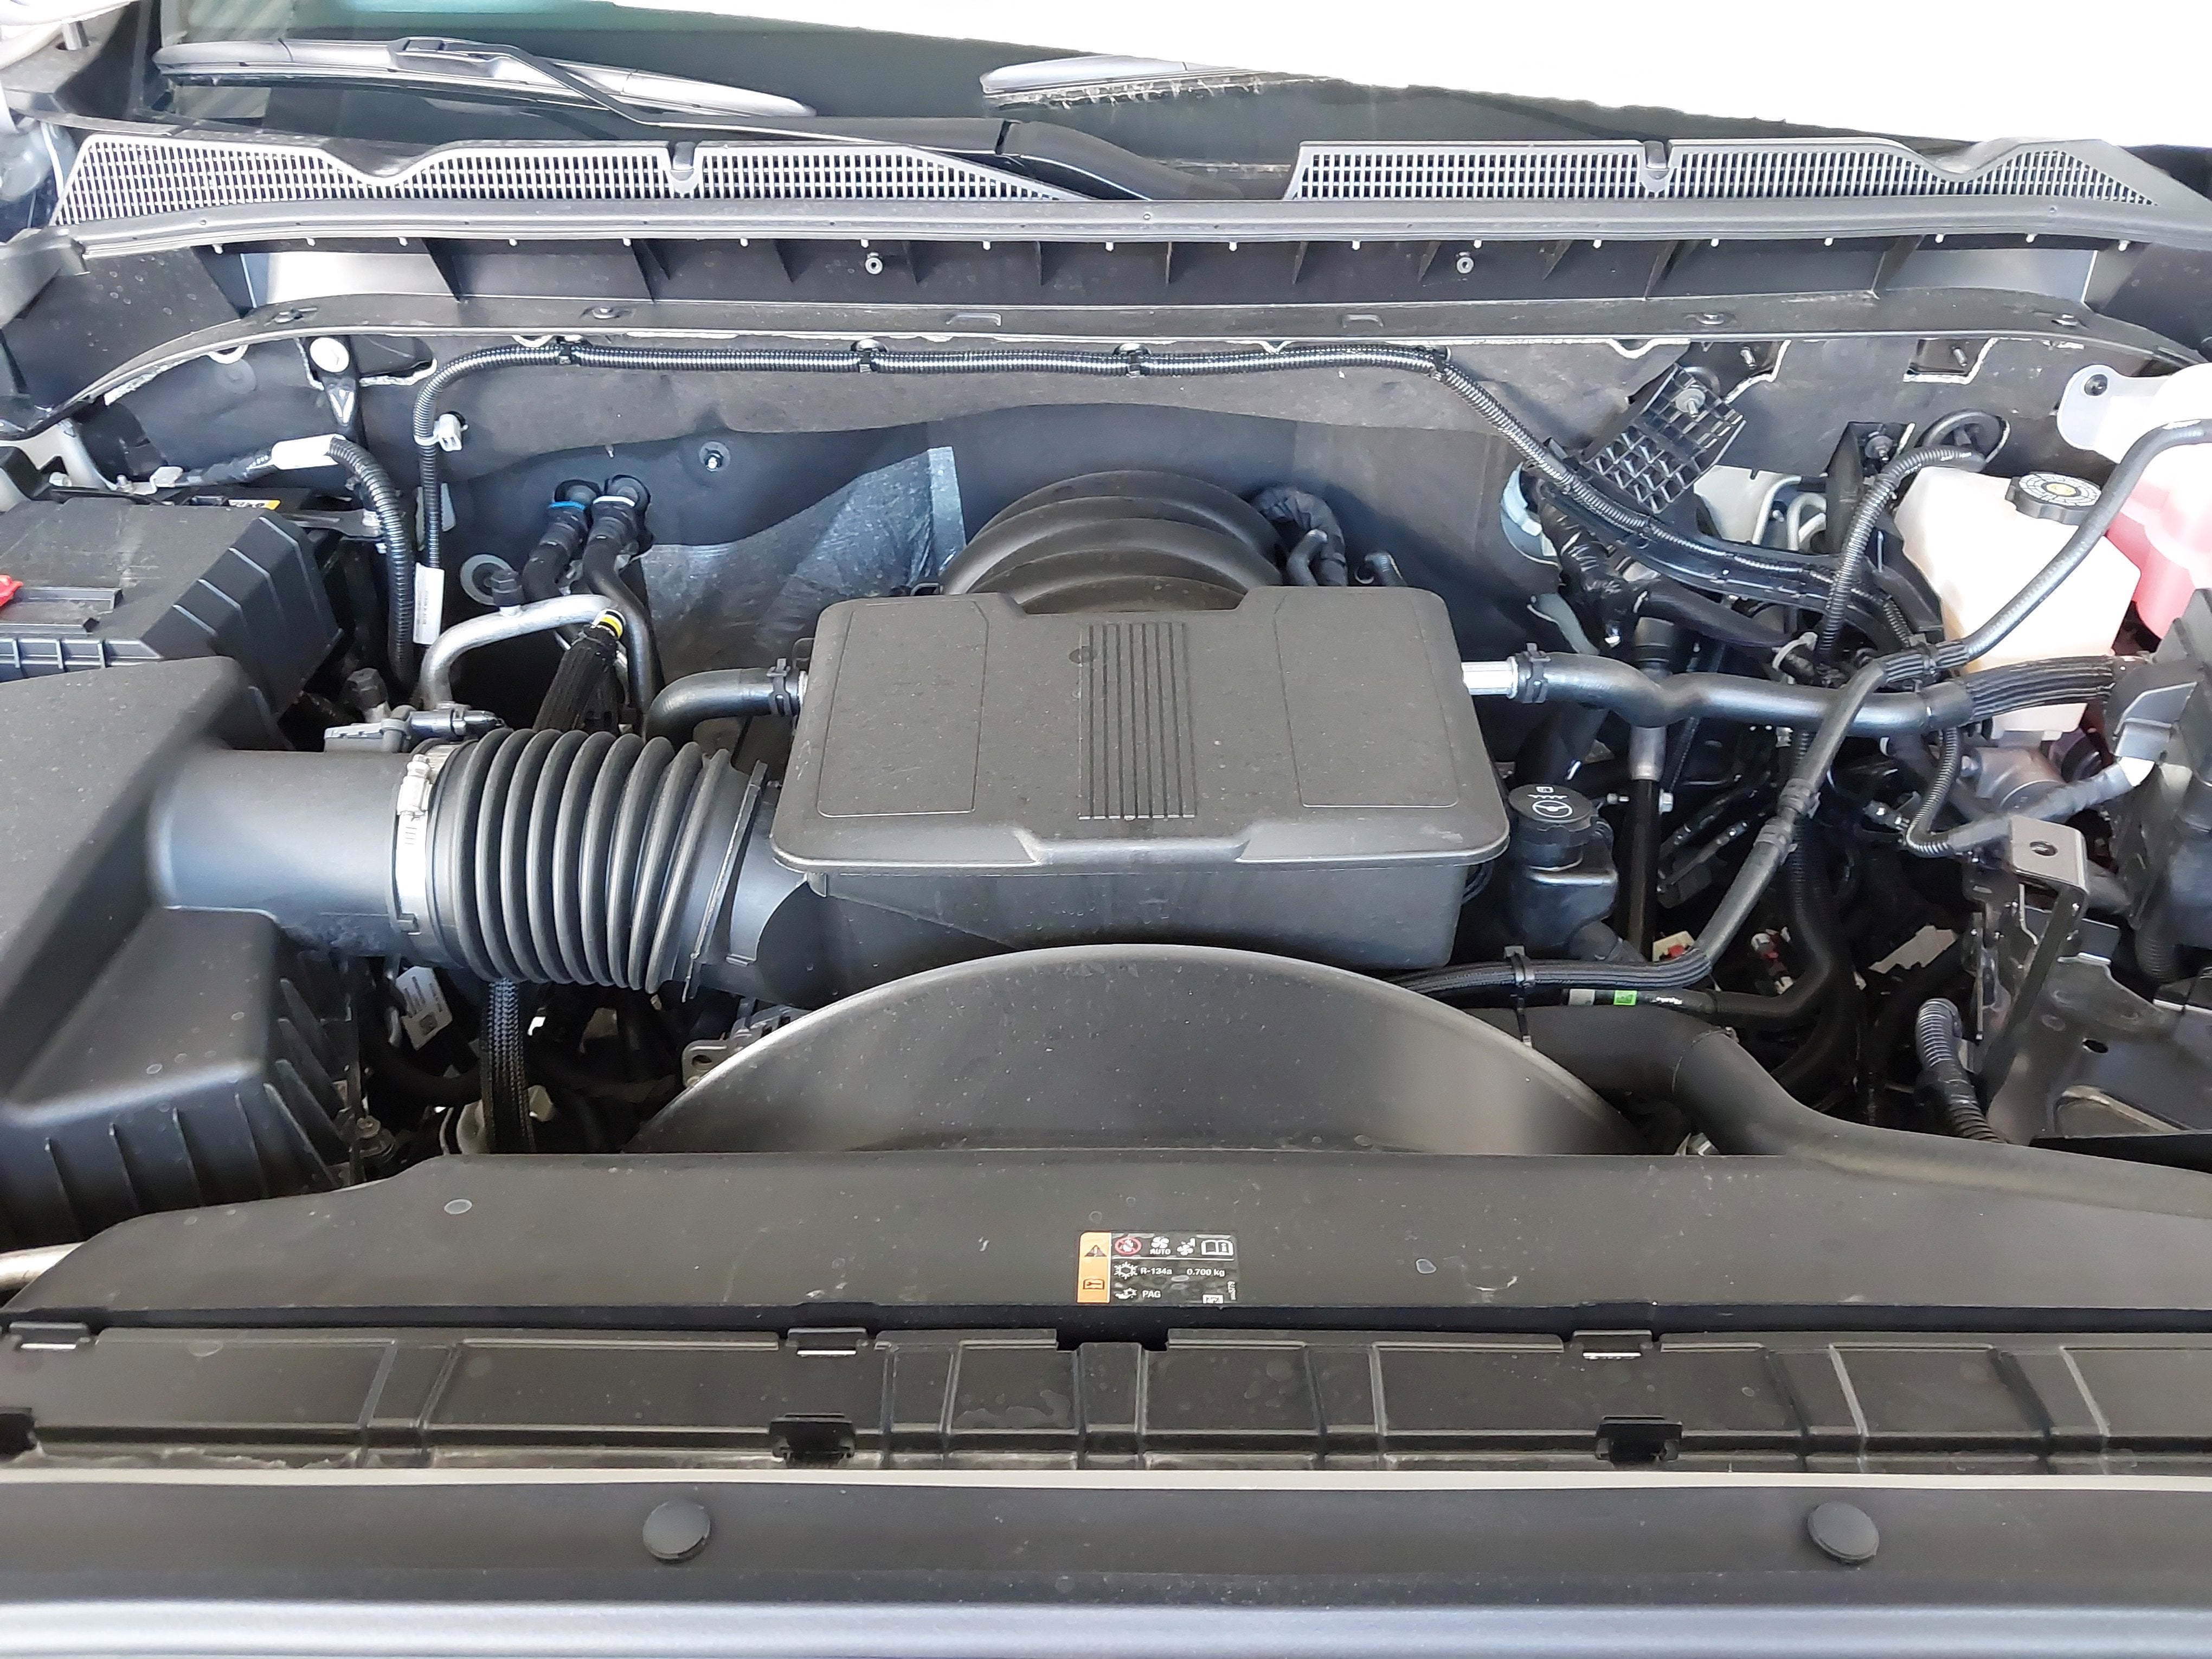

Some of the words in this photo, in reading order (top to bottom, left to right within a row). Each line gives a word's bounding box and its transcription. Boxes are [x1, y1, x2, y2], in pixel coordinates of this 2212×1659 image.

[1140, 1267, 1173, 1275] R-134a
[1214, 1268, 1225, 1277] kg
[1142, 1290, 1161, 1298] PAG
